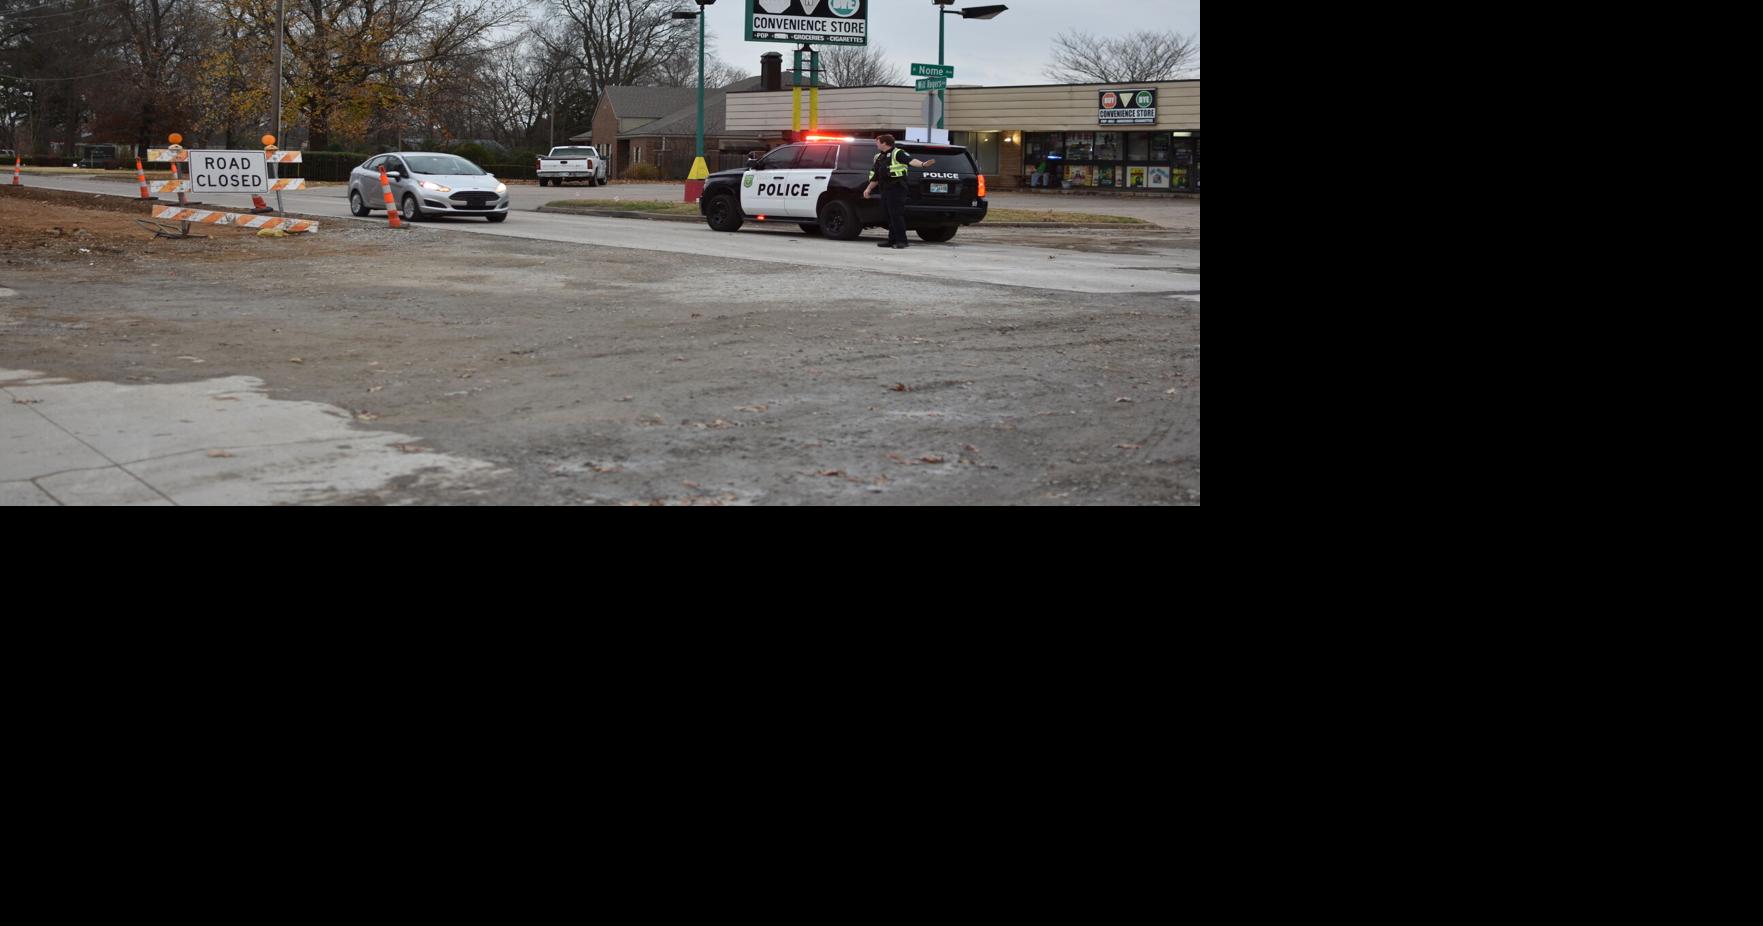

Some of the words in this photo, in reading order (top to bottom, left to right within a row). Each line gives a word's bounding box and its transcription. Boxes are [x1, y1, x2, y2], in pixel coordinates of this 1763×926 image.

[753, 16, 827, 32] CONVENIENCE
[830, 20, 864, 34] STORE
[919, 65, 944, 76] Nome
[1099, 109, 1136, 118] CONVENIENCE
[1136, 109, 1154, 118] STORE
[205, 157, 251, 170] ROAD
[196, 174, 262, 187] CLOSED
[922, 171, 960, 179] POLICE
[757, 183, 811, 197] POLICE
